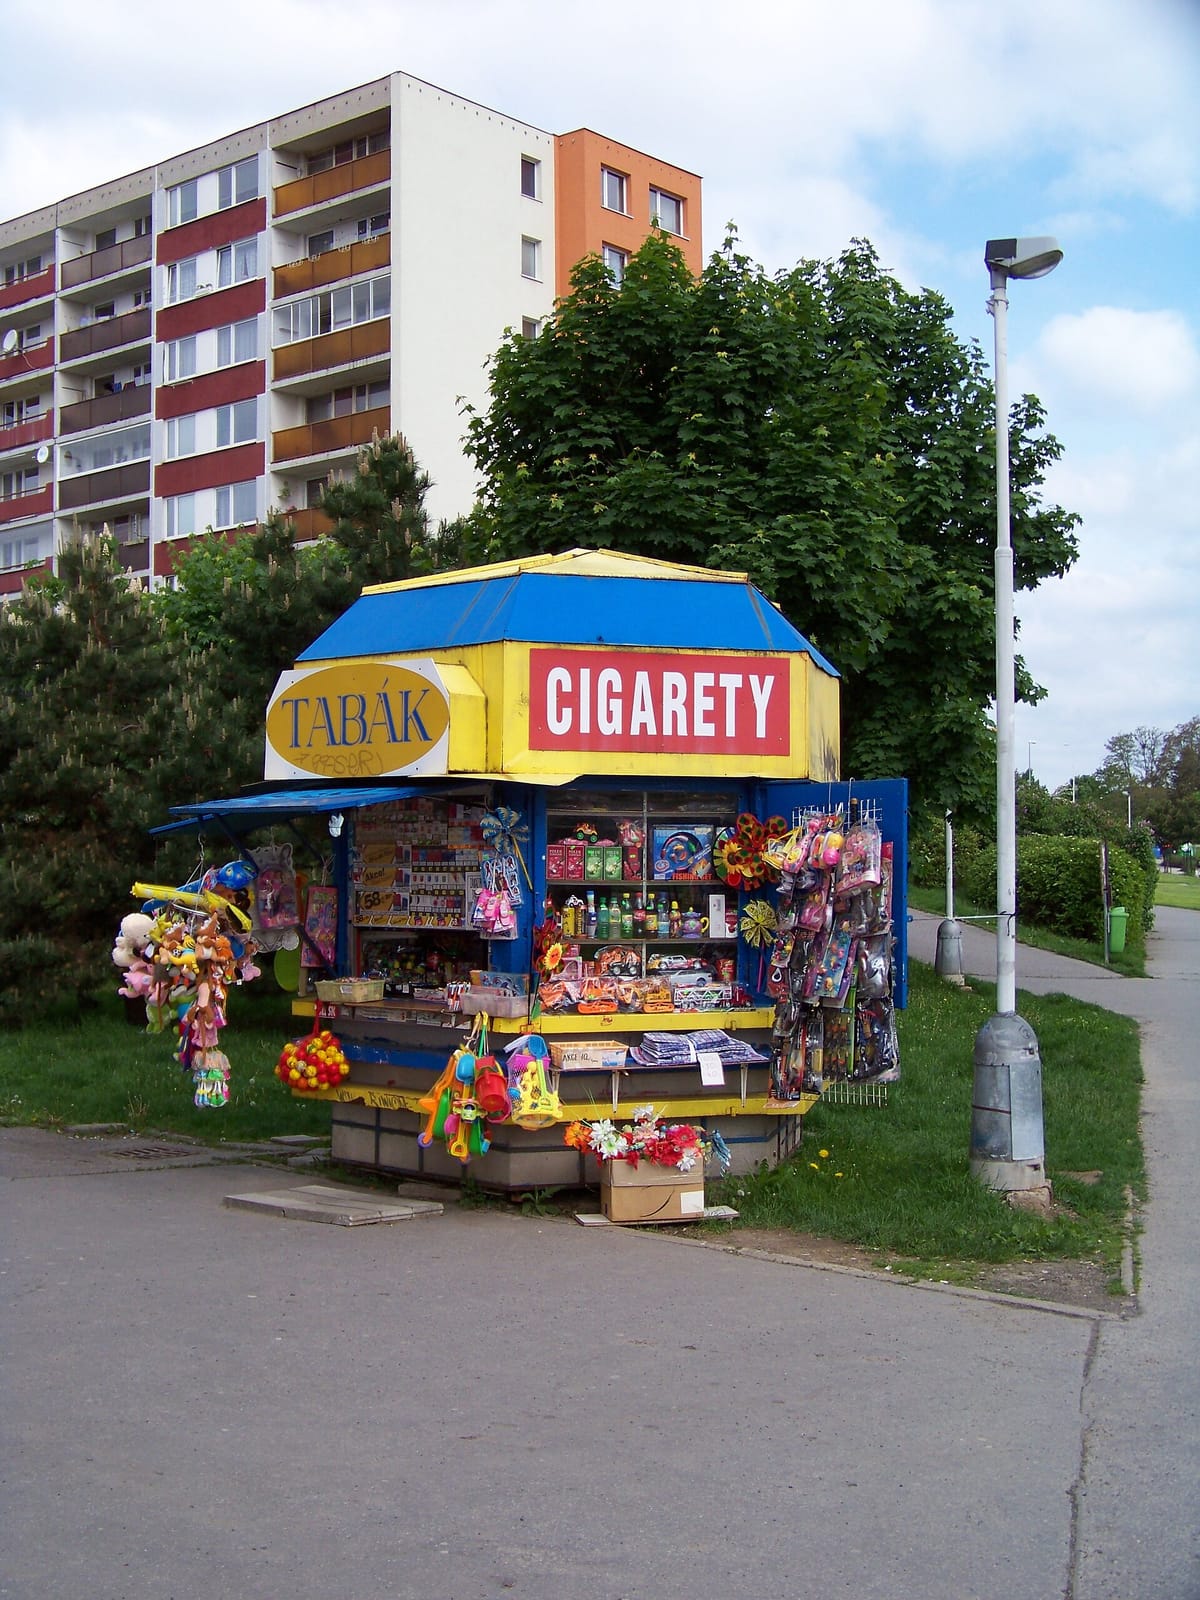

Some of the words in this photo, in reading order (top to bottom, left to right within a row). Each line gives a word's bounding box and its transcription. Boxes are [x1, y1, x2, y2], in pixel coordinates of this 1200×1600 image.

[281, 677, 433, 749] TABÁK
[546, 666, 775, 739] CIGARETY
[364, 891, 381, 909] 58
